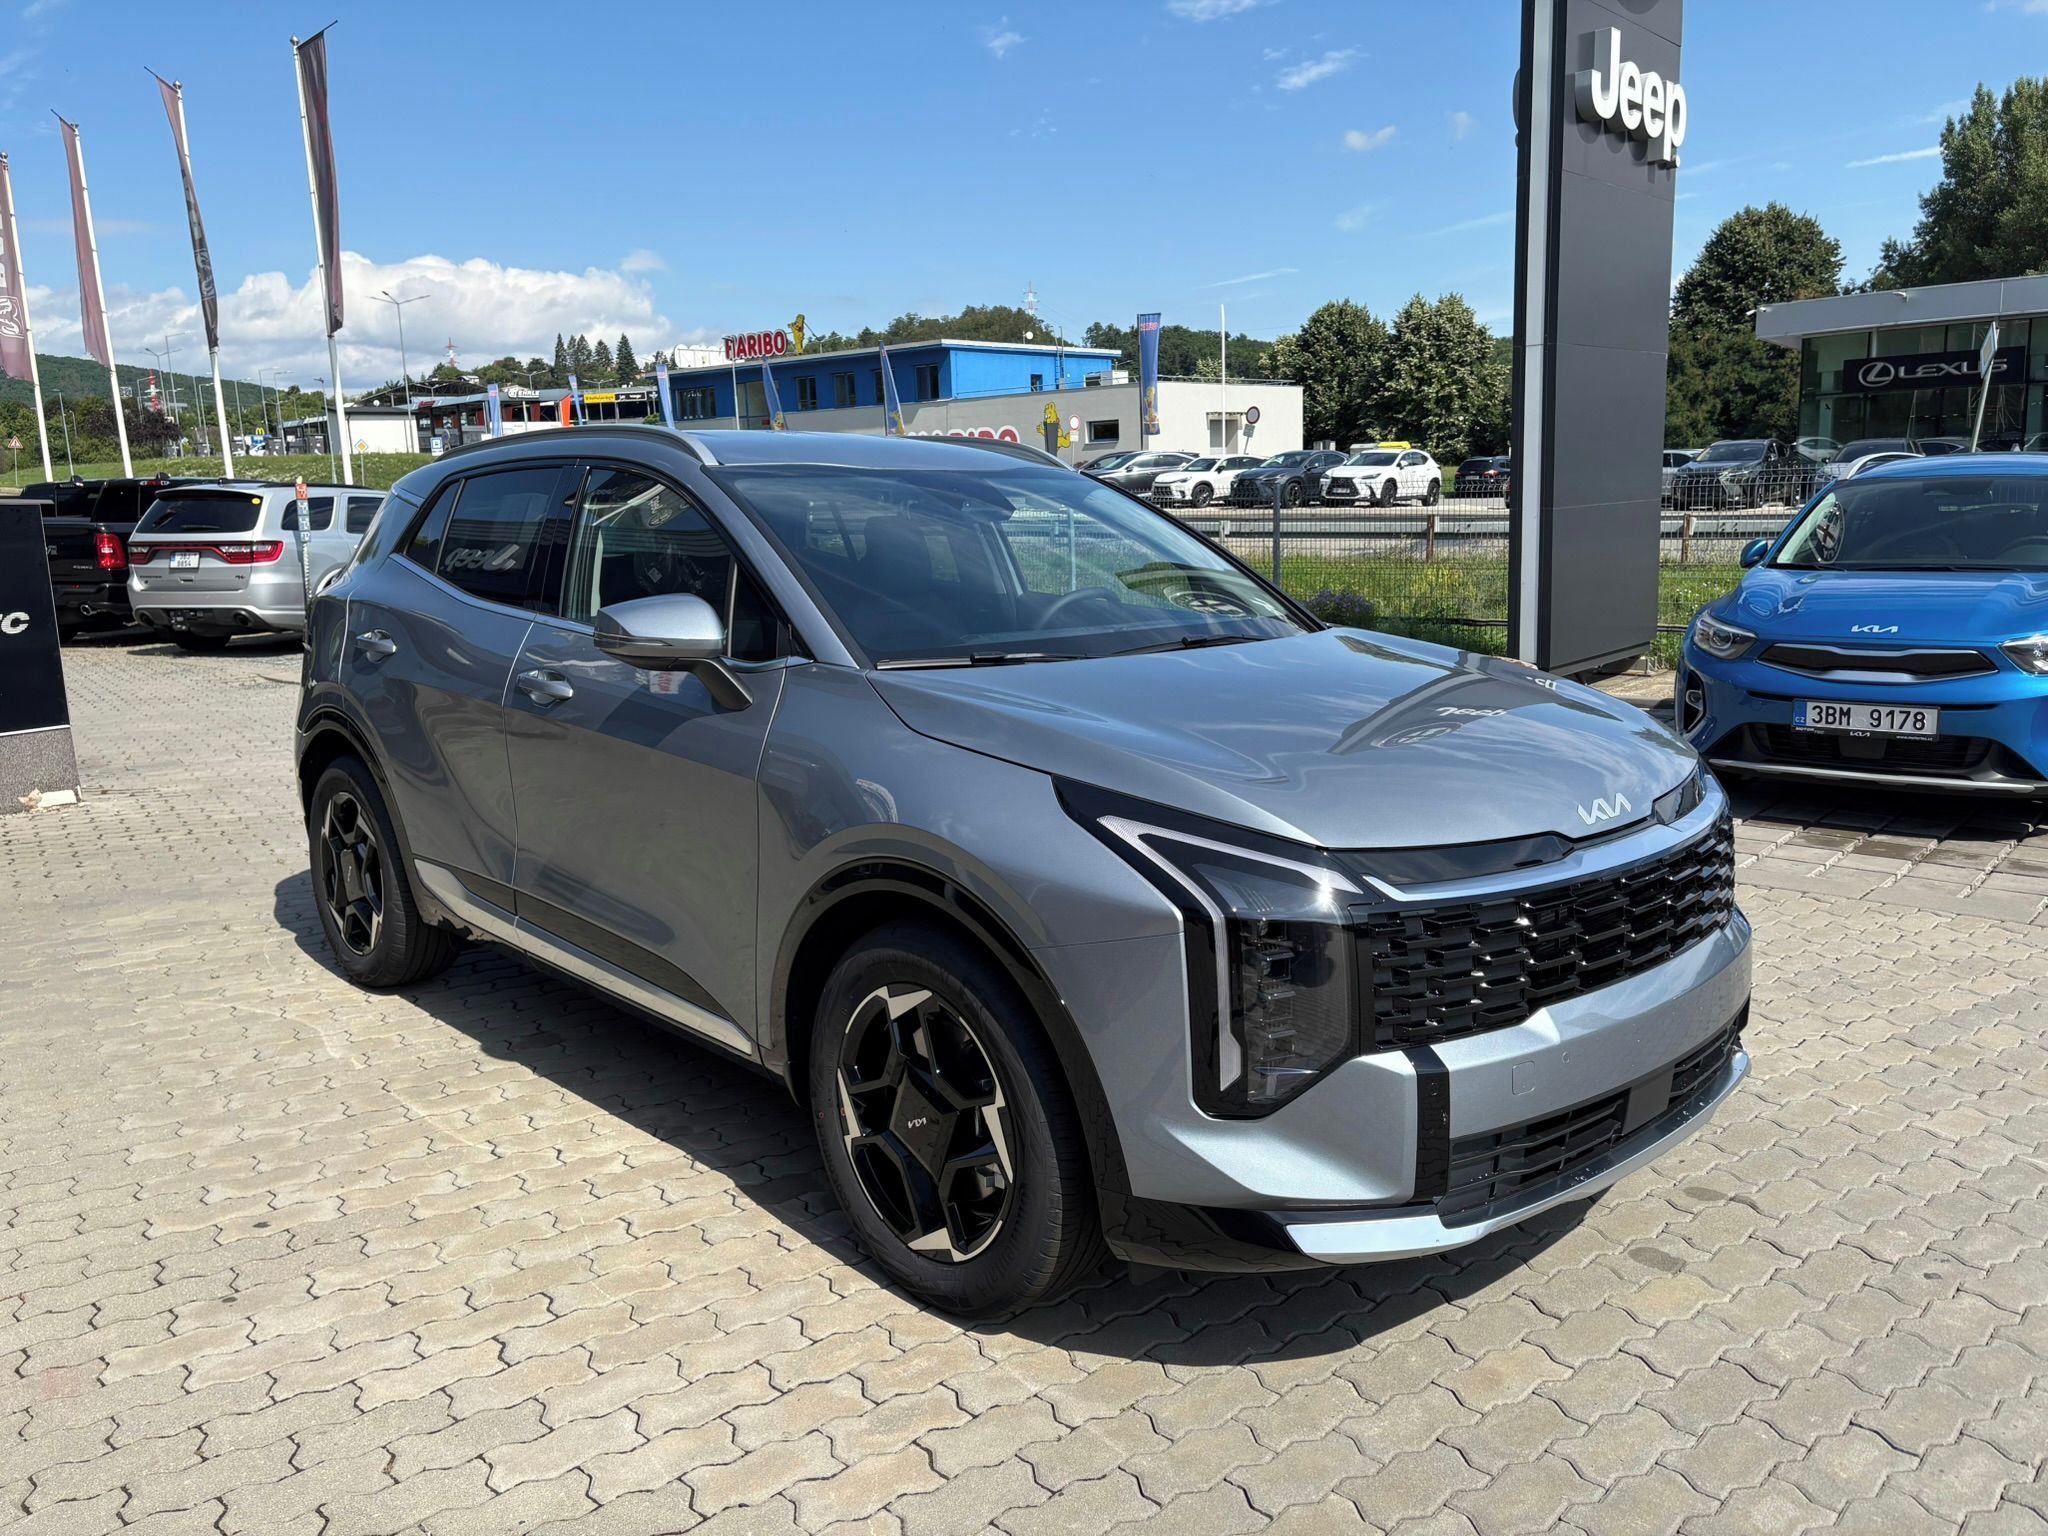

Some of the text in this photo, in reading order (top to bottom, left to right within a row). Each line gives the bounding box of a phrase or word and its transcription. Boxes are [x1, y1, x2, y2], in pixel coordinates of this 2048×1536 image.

[1589, 27, 1687, 162] Jeep
[724, 330, 787, 360] HARIBO
[1898, 357, 2008, 379] LEXUS
[1851, 624, 1899, 633] KIA
[1812, 705, 1926, 731] 3BM 9178
[1577, 793, 1632, 825] KIA
